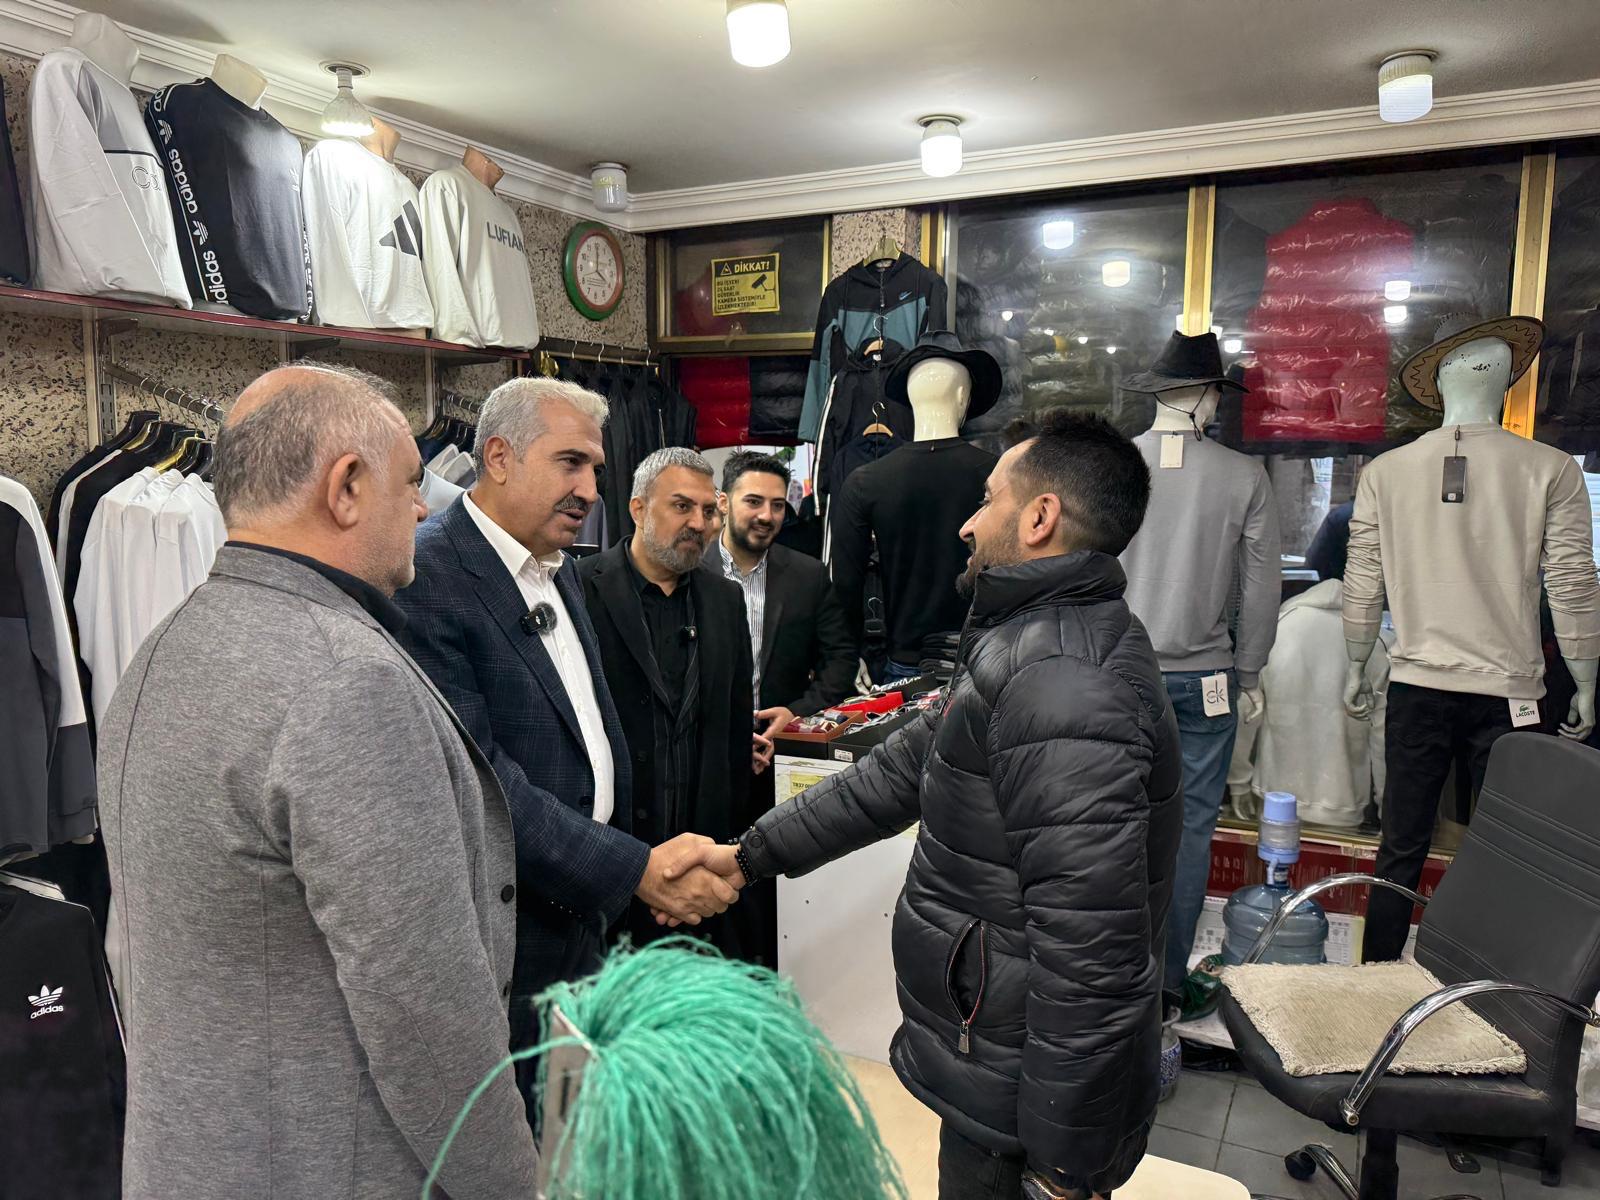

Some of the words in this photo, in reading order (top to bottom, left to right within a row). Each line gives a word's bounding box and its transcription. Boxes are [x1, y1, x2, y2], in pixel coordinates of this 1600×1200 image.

[169, 148, 198, 214] adidas
[203, 250, 229, 305] didas
[734, 261, 770, 273] DİKKAT!
[30, 1005, 64, 1019] adidas
